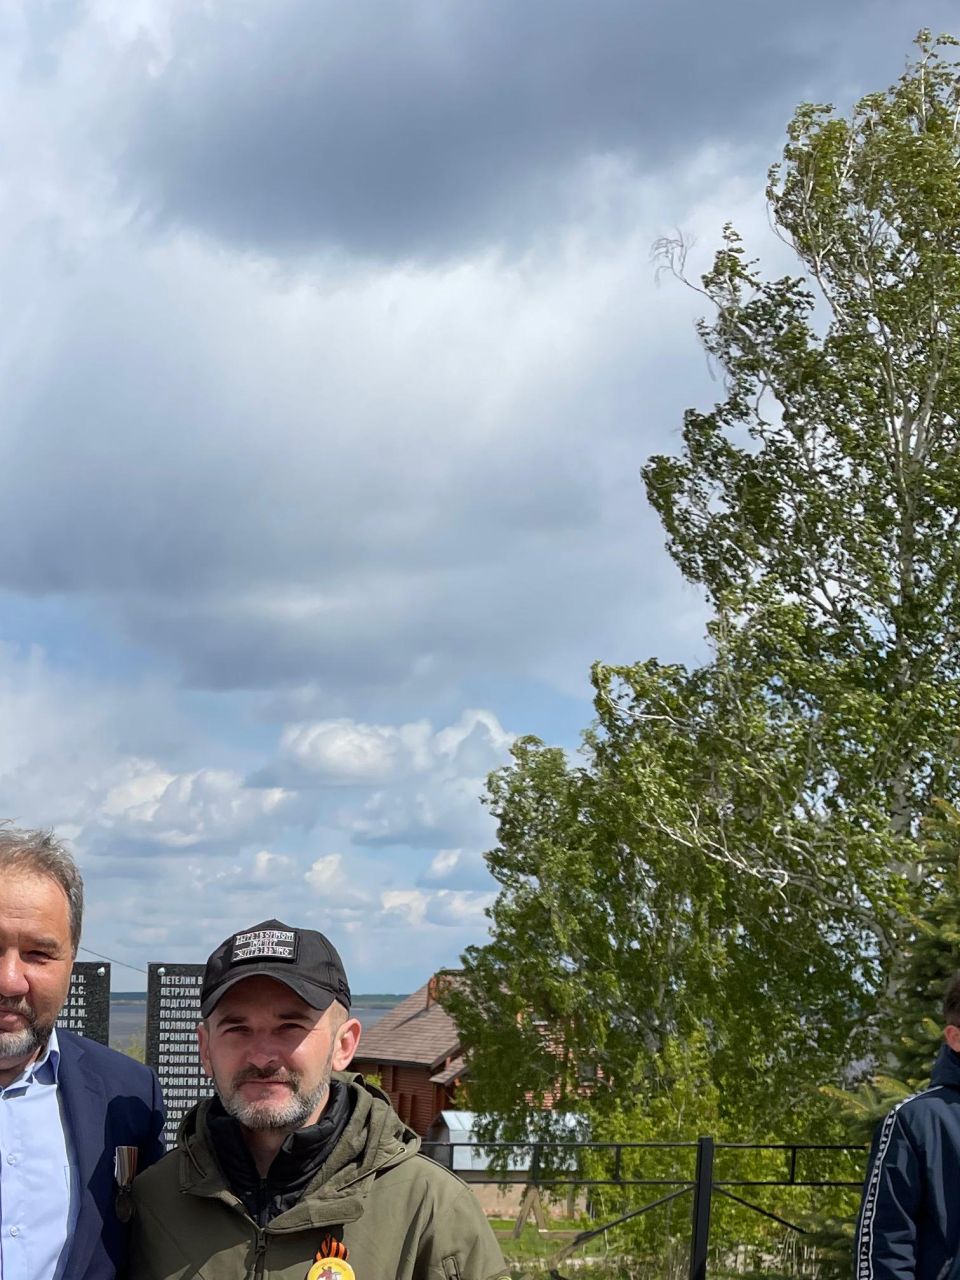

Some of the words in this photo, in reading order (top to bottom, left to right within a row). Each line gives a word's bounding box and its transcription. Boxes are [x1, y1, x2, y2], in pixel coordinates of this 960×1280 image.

[161, 976, 196, 984] ПЕТЕЛИН
[198, 976, 203, 984] В
[71, 986, 86, 995] А.С.
[161, 988, 200, 996] ПЕТРУХИН
[71, 997, 86, 1006] А.И.
[160, 999, 201, 1008] ПОДГОРНО
[70, 1008, 88, 1017] Я.М.
[160, 1010, 203, 1019] ПОЛКОВНИ
[70, 1020, 85, 1028] П.А.
[159, 1044, 199, 1052] ПРОНЯГИН
[159, 1055, 199, 1063] ПРОНЯГИН
[158, 1066, 198, 1074] ПРОНЯГИН
[200, 1077, 214, 1086] В.Г.
[163, 1088, 198, 1097] РОНЯГИН
[200, 1089, 215, 1097] М.В
[862, 1196, 875, 1242] JORDAN
